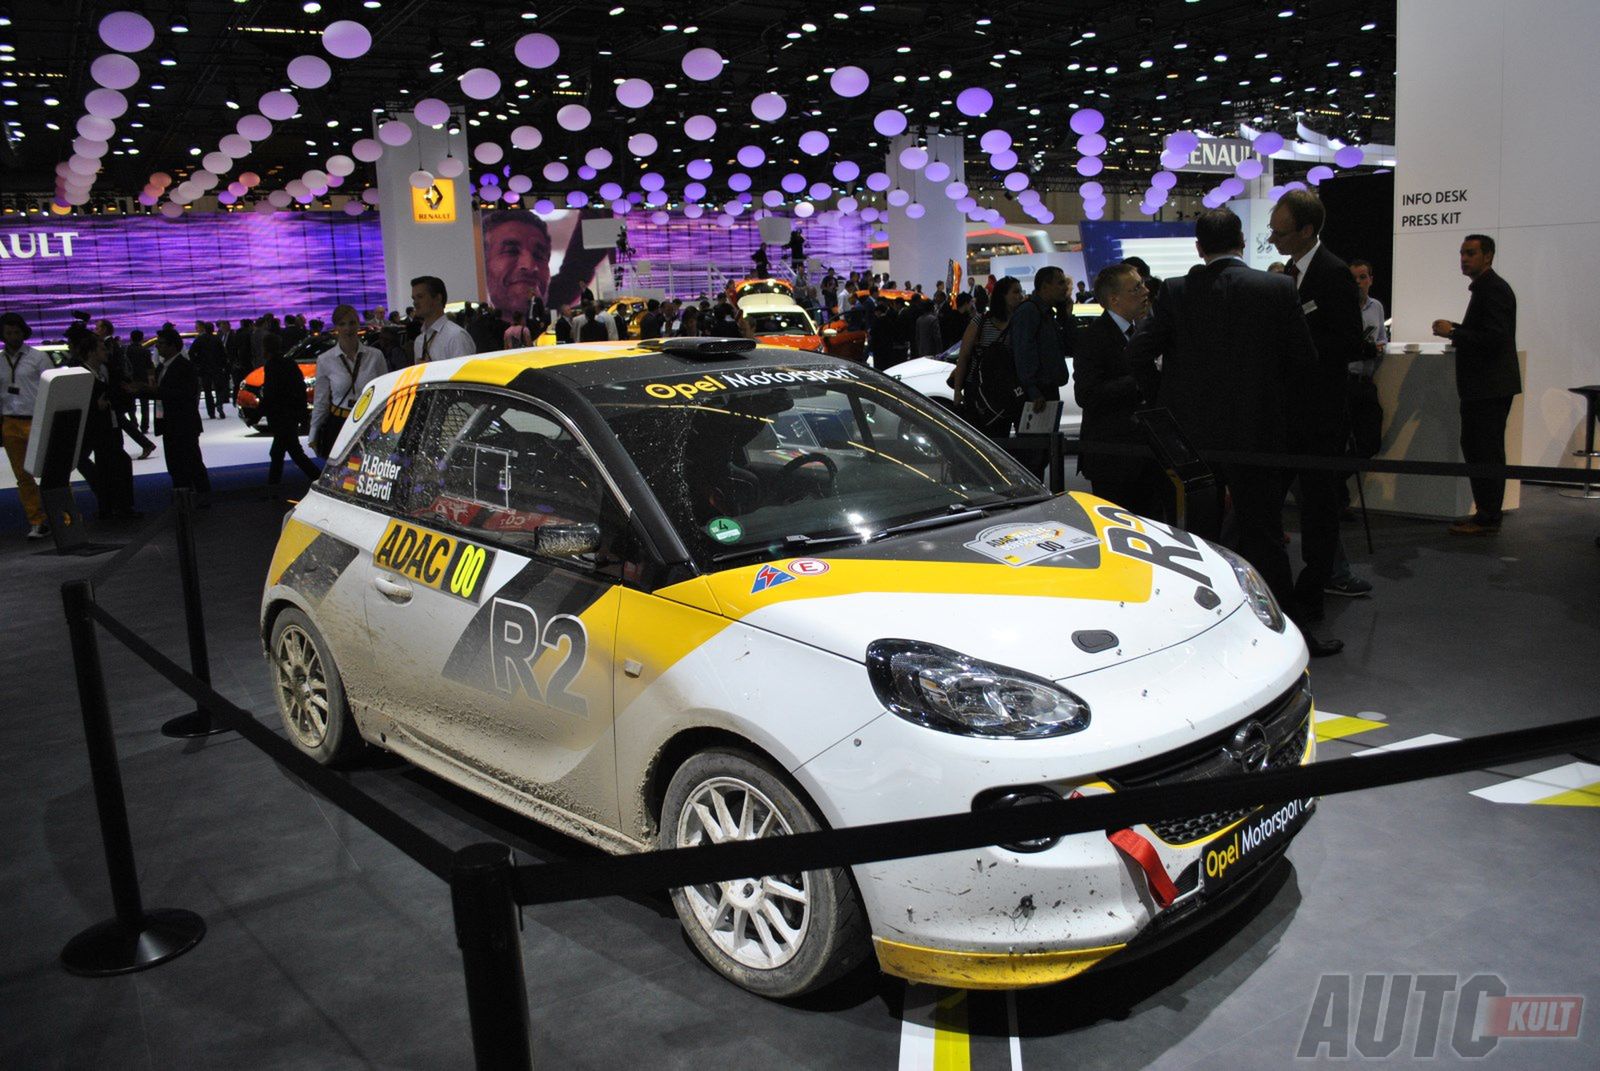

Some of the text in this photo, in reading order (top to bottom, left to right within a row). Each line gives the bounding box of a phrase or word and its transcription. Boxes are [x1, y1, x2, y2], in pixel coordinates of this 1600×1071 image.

[1402, 189, 1468, 206] INFO DESK
[1402, 212, 1461, 227] PRESS KIT
[644, 367, 860, 399] Opel Motorsport
[376, 524, 487, 598] ADAC 00
[799, 561, 818, 572] E
[490, 597, 590, 718] R2
[1206, 832, 1239, 878] Opel
